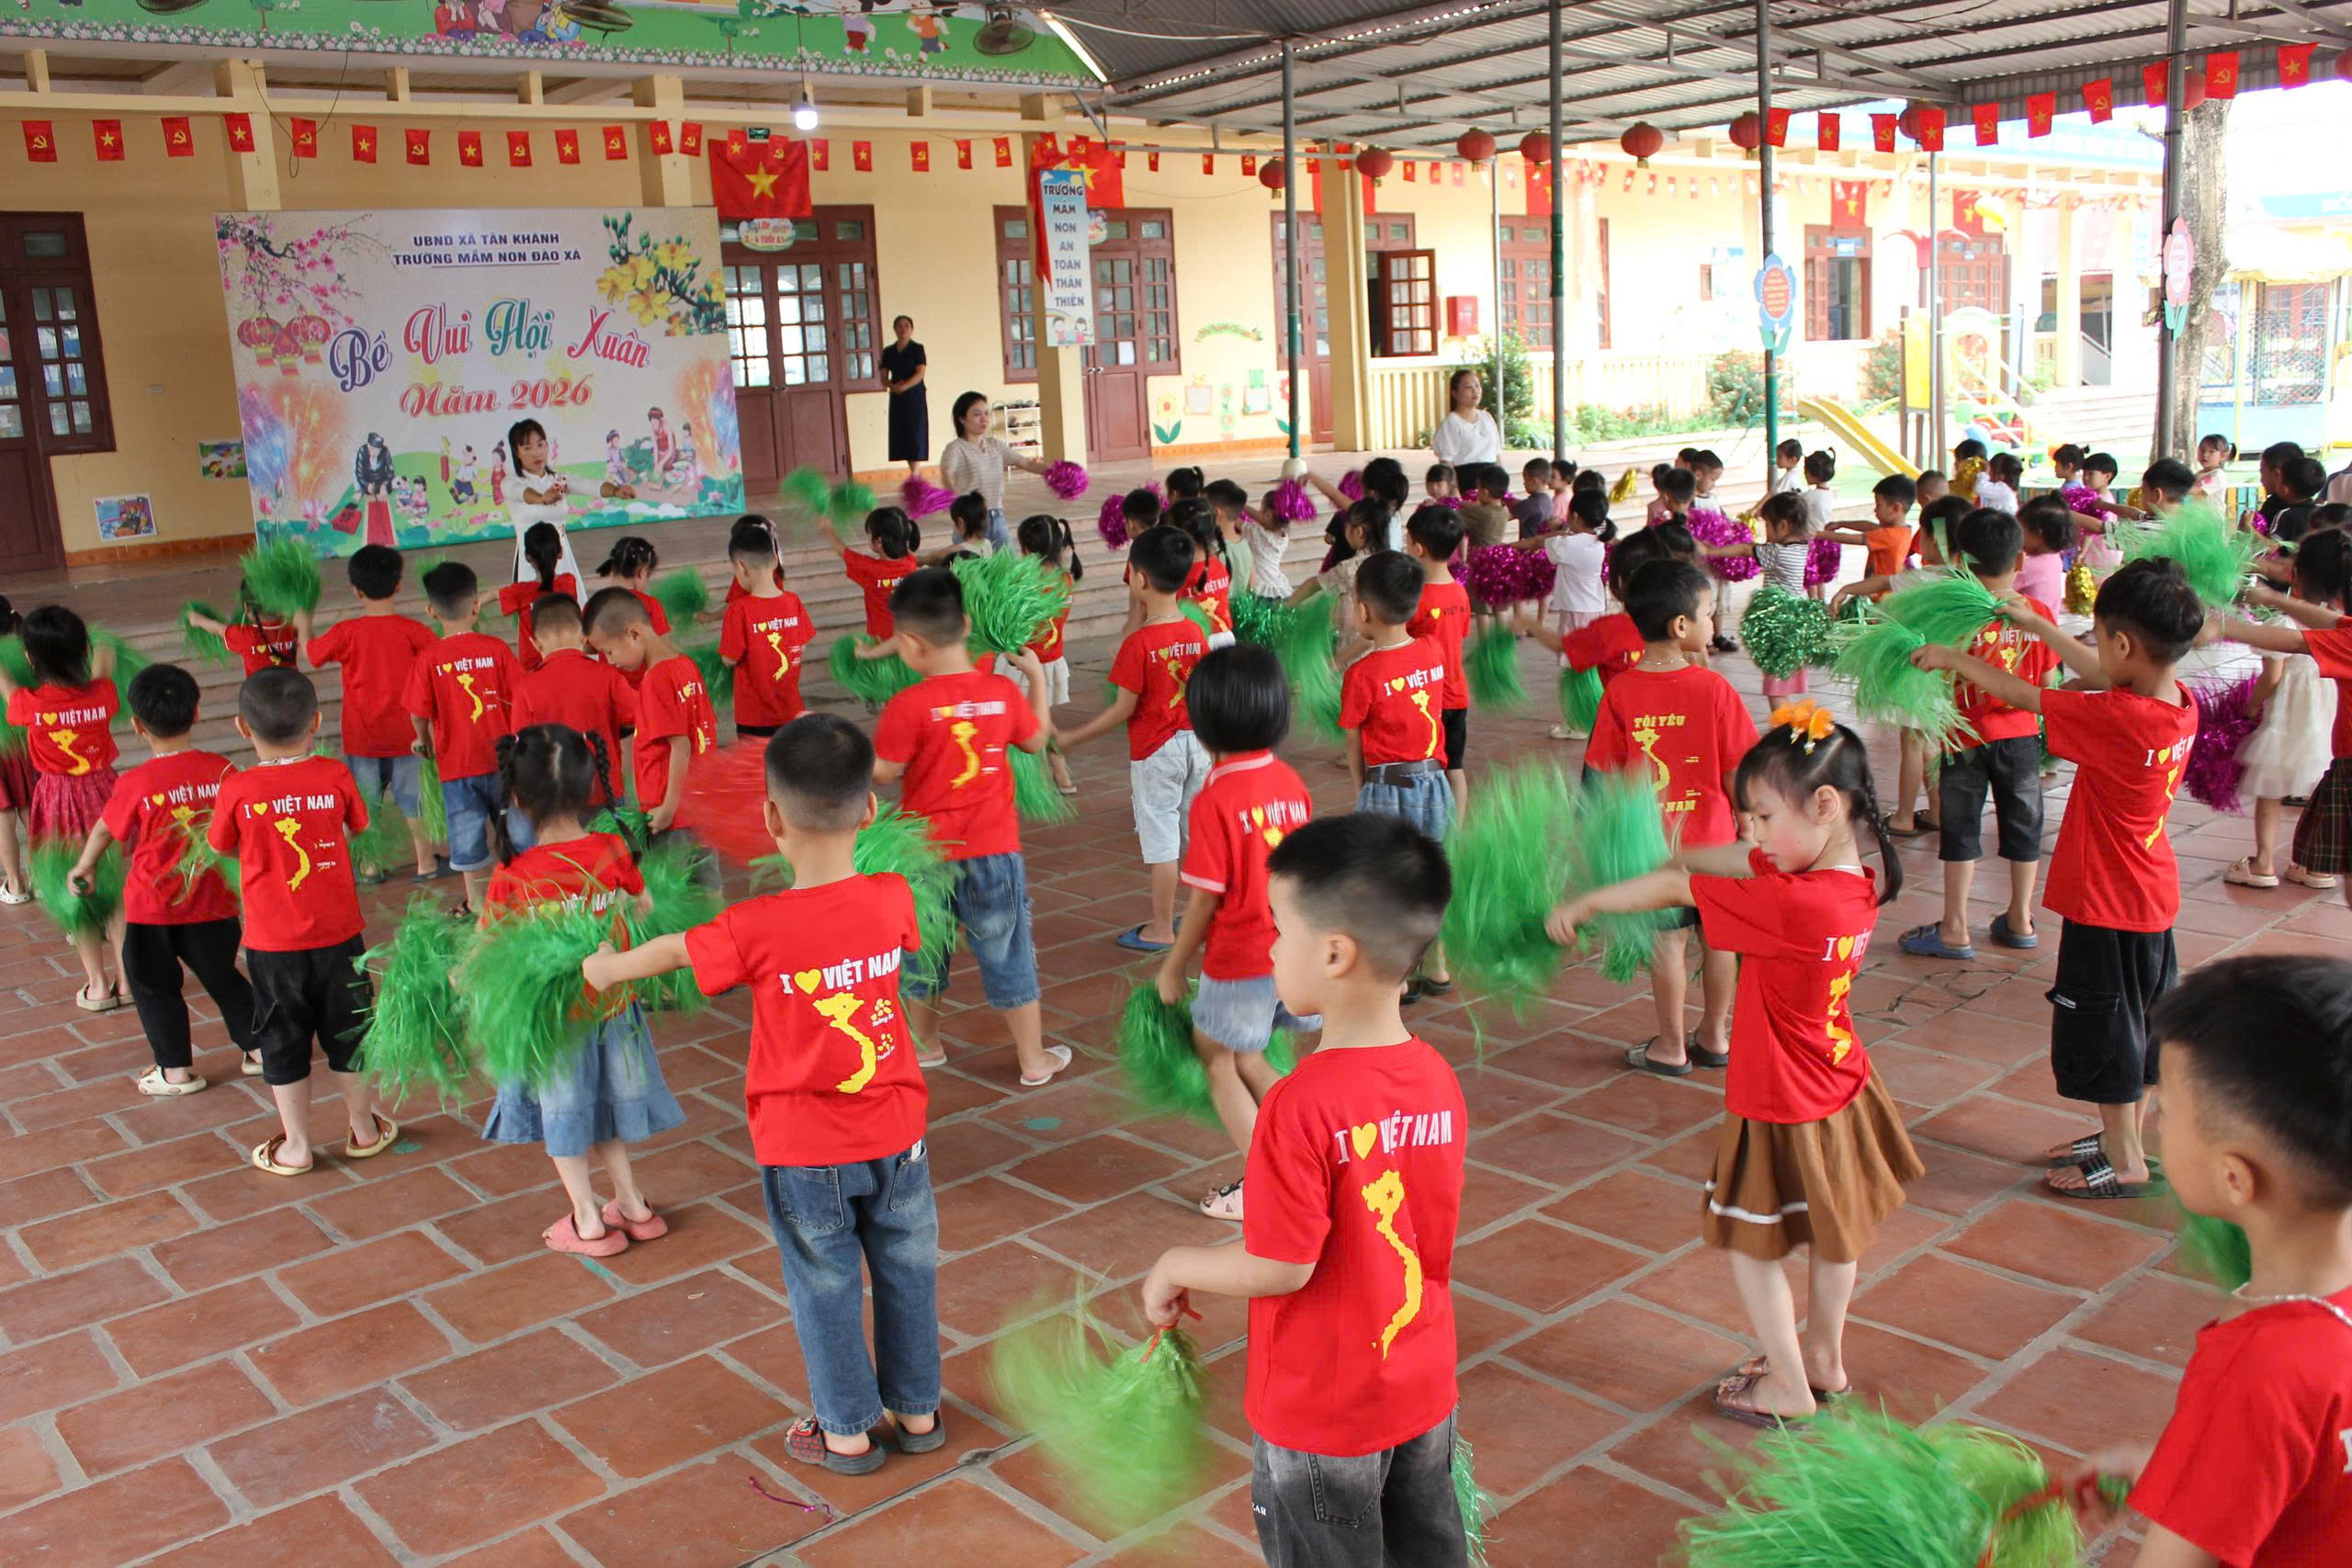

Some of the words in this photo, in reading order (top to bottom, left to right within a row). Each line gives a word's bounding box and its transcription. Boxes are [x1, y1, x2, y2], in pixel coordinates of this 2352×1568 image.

[1055, 222, 1076, 232] NON
[413, 235, 454, 247] UBND
[513, 231, 560, 244] KHÁNH
[1059, 241, 1074, 252] AN
[393, 251, 453, 265] TRƯỜNG
[458, 249, 493, 264] MẦM
[498, 252, 526, 263] NON
[531, 248, 560, 262] ĐÀO
[330, 326, 392, 392] Bé
[403, 302, 472, 366] Vui
[484, 298, 555, 359] Hội
[566, 306, 651, 368] Xuân
[399, 381, 498, 418] Năm
[507, 373, 594, 411] 2026
[752, 623, 758, 634] I
[767, 617, 784, 632] VIỆT
[1149, 649, 1158, 663] I
[1169, 641, 1185, 660] VIỆT
[435, 665, 443, 677] I
[454, 657, 473, 672] VIỆT
[475, 656, 493, 669] NAM
[1384, 682, 1393, 697] I
[1406, 669, 1429, 689] VIỆT
[34, 712, 42, 727] I
[59, 707, 82, 728] VIỆT
[83, 705, 107, 723] NAM
[1634, 714, 1657, 728] TÔI
[1658, 713, 1686, 727] YÊU
[2143, 749, 2155, 767] I
[142, 795, 151, 811] I
[168, 784, 194, 805] VIỆT
[243, 804, 252, 819] I
[272, 794, 302, 816] VIỆT
[306, 794, 334, 810] NAM
[1238, 809, 1253, 835] I
[1821, 937, 1838, 962] I
[779, 974, 794, 995] I
[822, 958, 864, 991] VIỆT
[1334, 1129, 1351, 1165] I
[1379, 1109, 1413, 1156] VỆT
[1411, 1110, 1453, 1147] NAM
